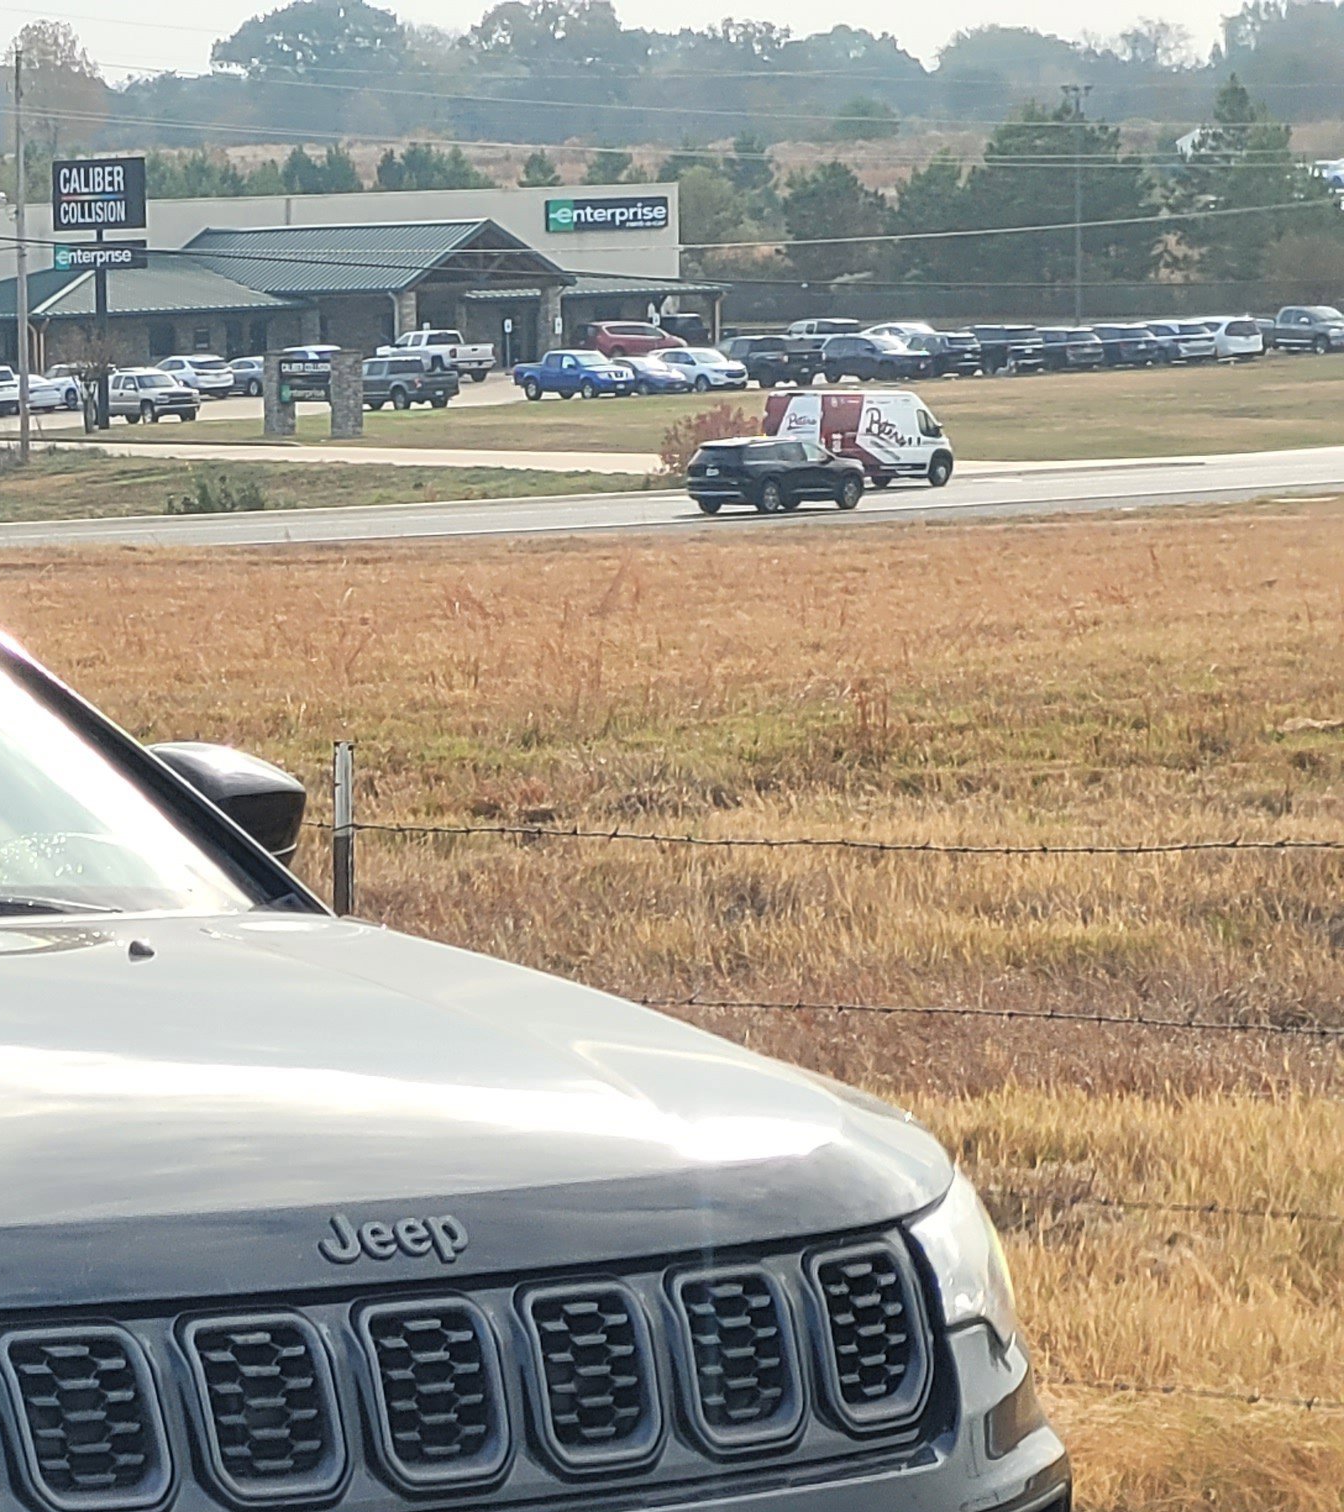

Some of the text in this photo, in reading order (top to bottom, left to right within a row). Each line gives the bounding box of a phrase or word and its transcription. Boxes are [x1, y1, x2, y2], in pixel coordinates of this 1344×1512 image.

[59, 166, 124, 194] CALIBER
[60, 200, 126, 224] COLLISION
[549, 202, 667, 226] enterprise
[56, 249, 132, 267] enterprise
[318, 1213, 469, 1264] Jeep
